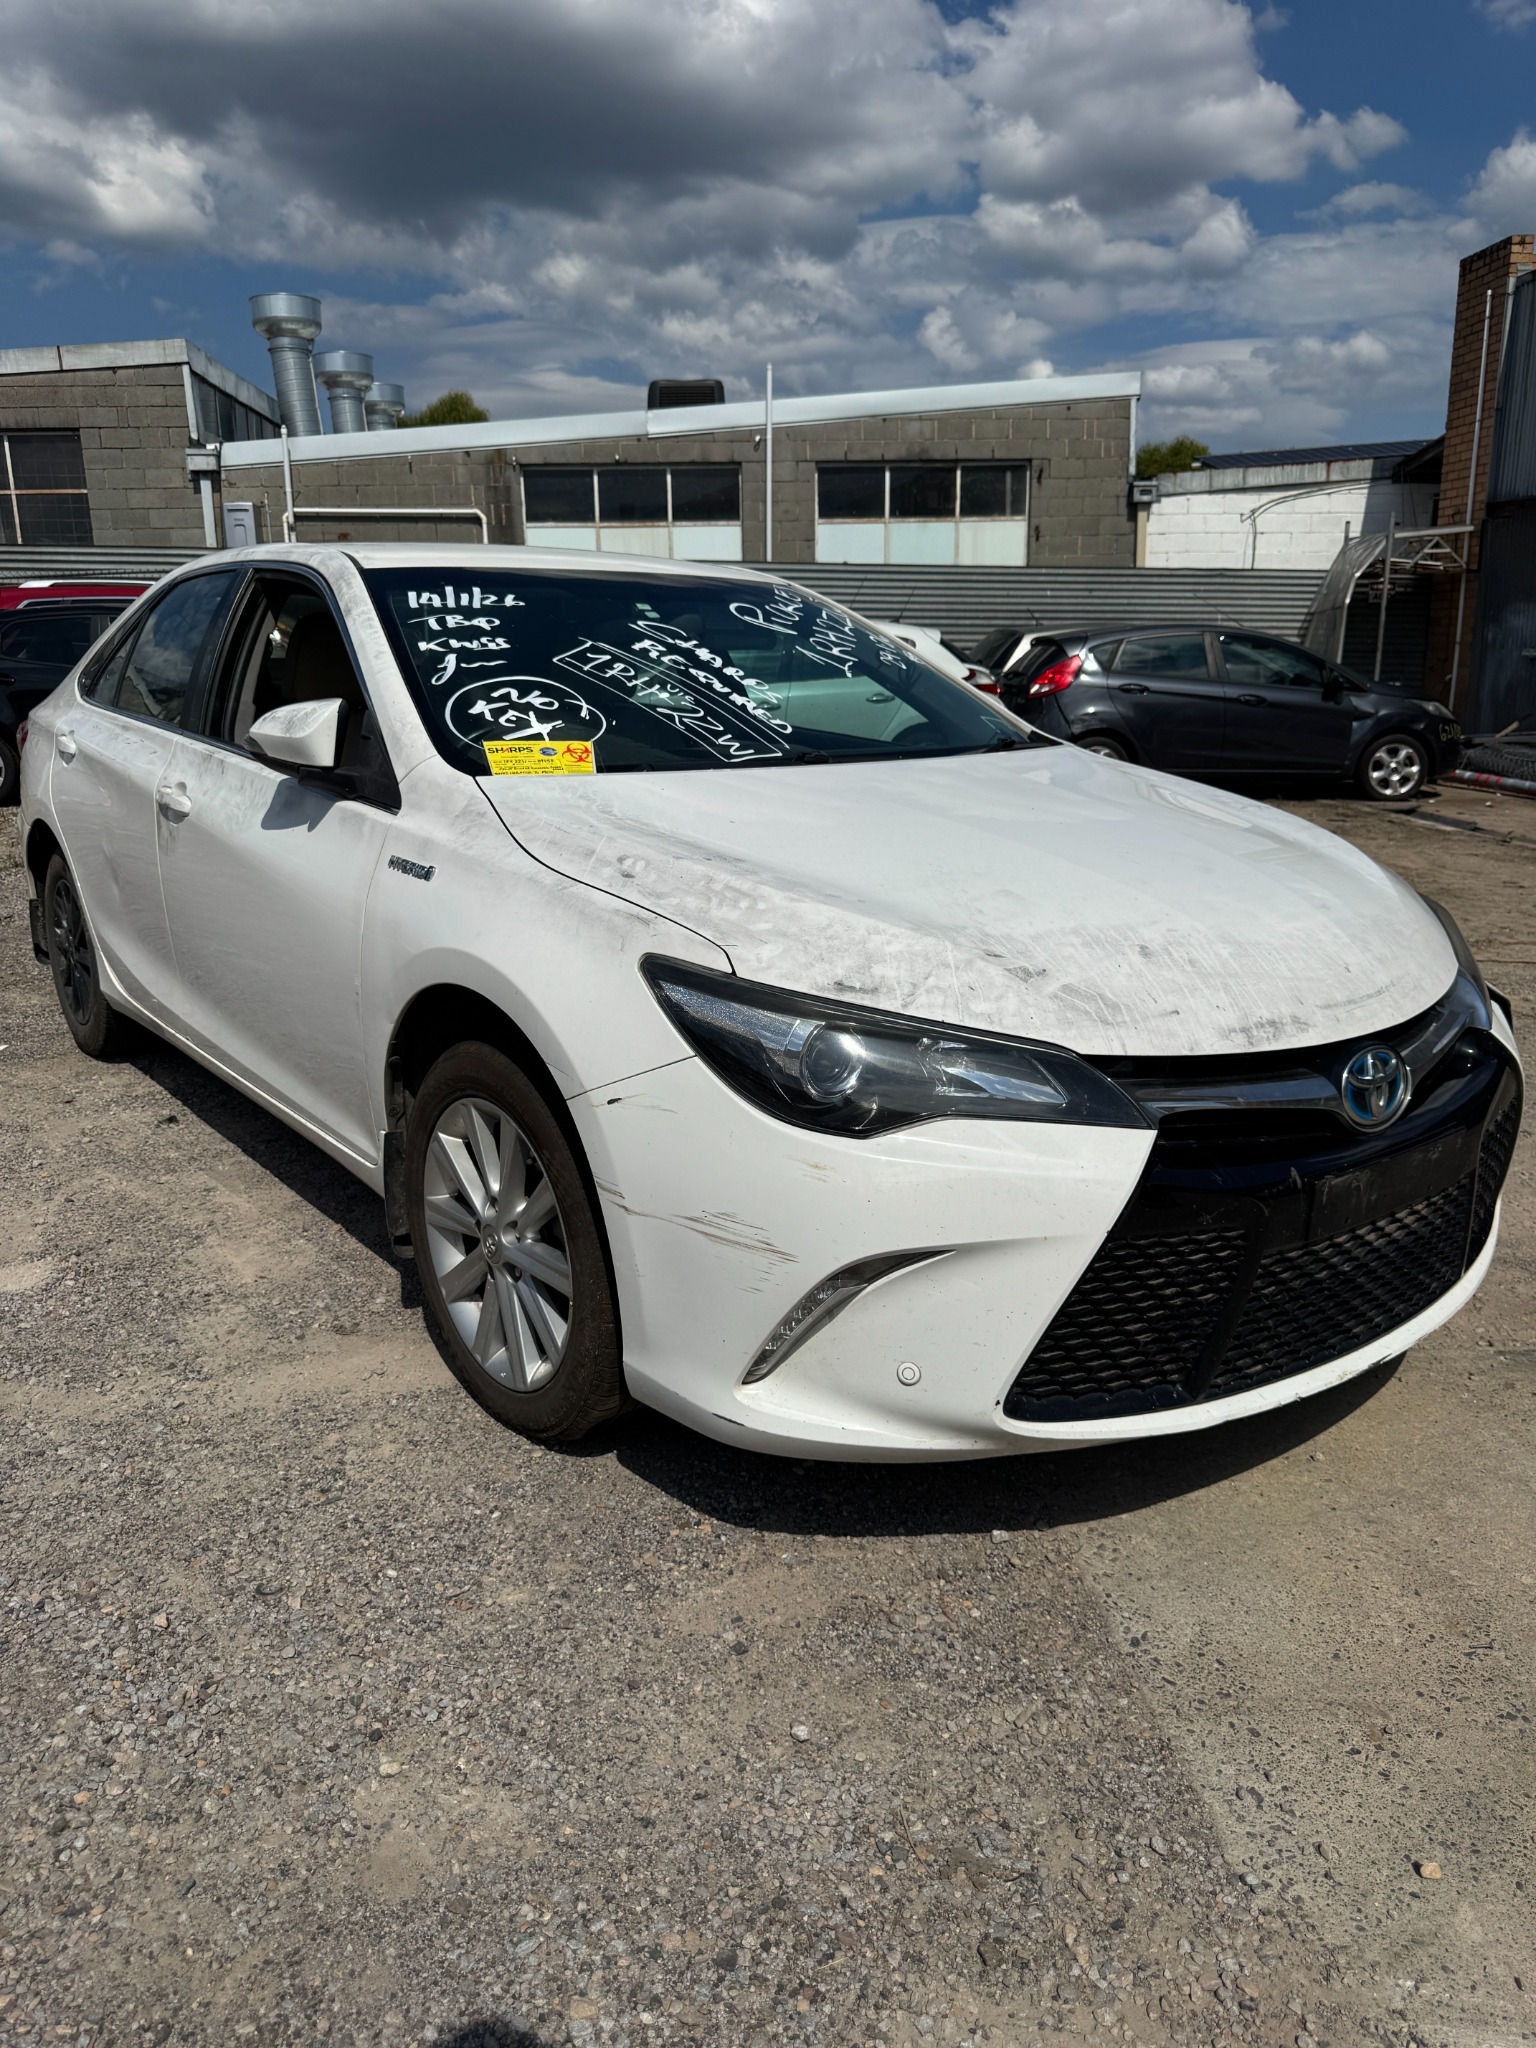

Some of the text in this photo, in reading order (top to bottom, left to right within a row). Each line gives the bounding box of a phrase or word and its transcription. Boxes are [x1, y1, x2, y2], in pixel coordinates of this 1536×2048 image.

[628, 620, 784, 703] SHARPS
[491, 688, 559, 711] NO
[468, 700, 562, 742] KEY
